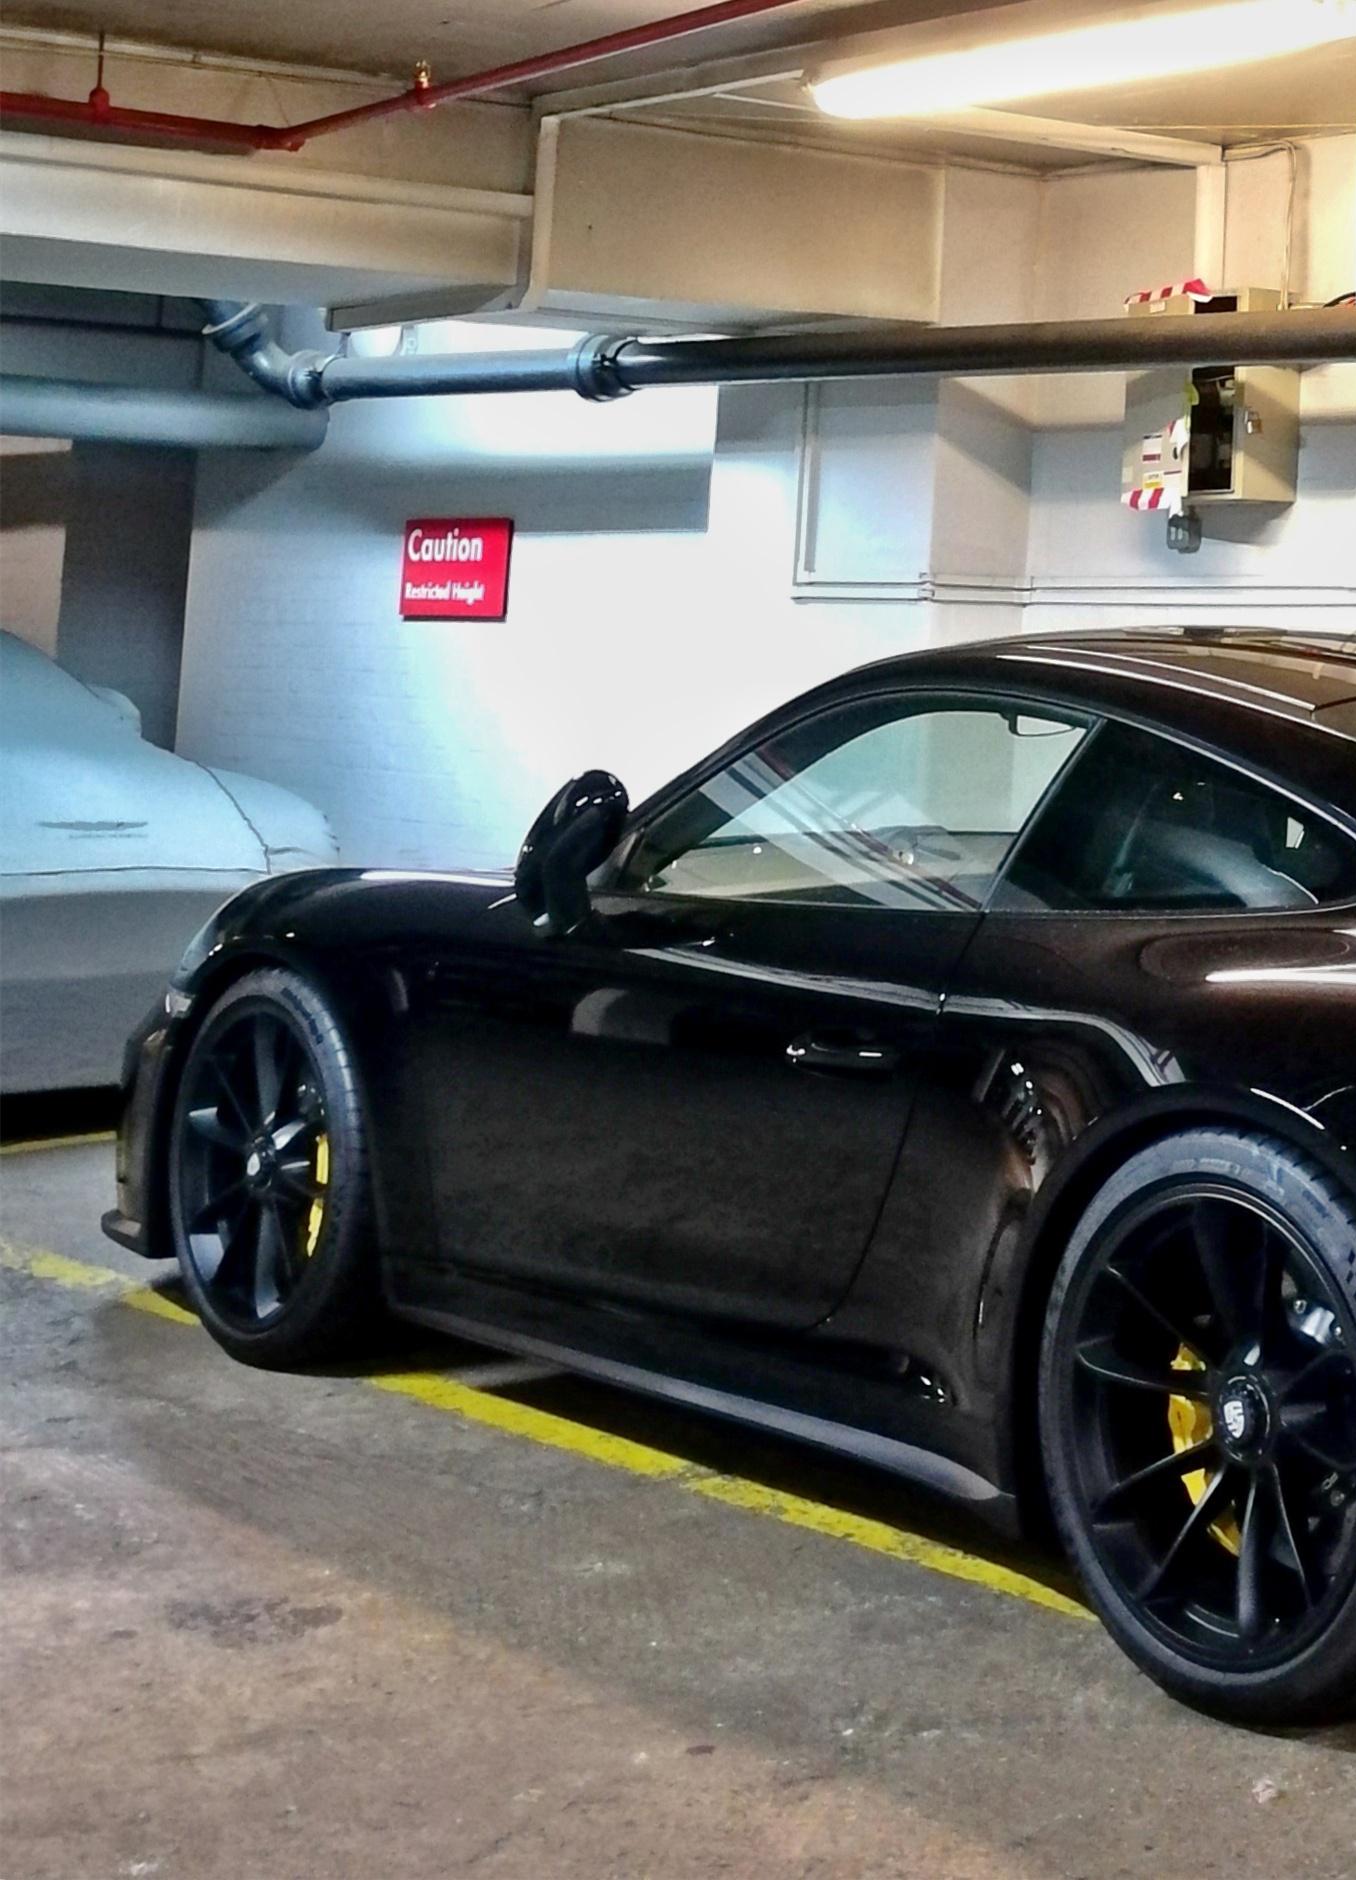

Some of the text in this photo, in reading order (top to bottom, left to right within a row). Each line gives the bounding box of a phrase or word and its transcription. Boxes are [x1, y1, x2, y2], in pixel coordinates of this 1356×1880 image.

[408, 528, 482, 561] Caution
[405, 580, 484, 605] Restricted Height
